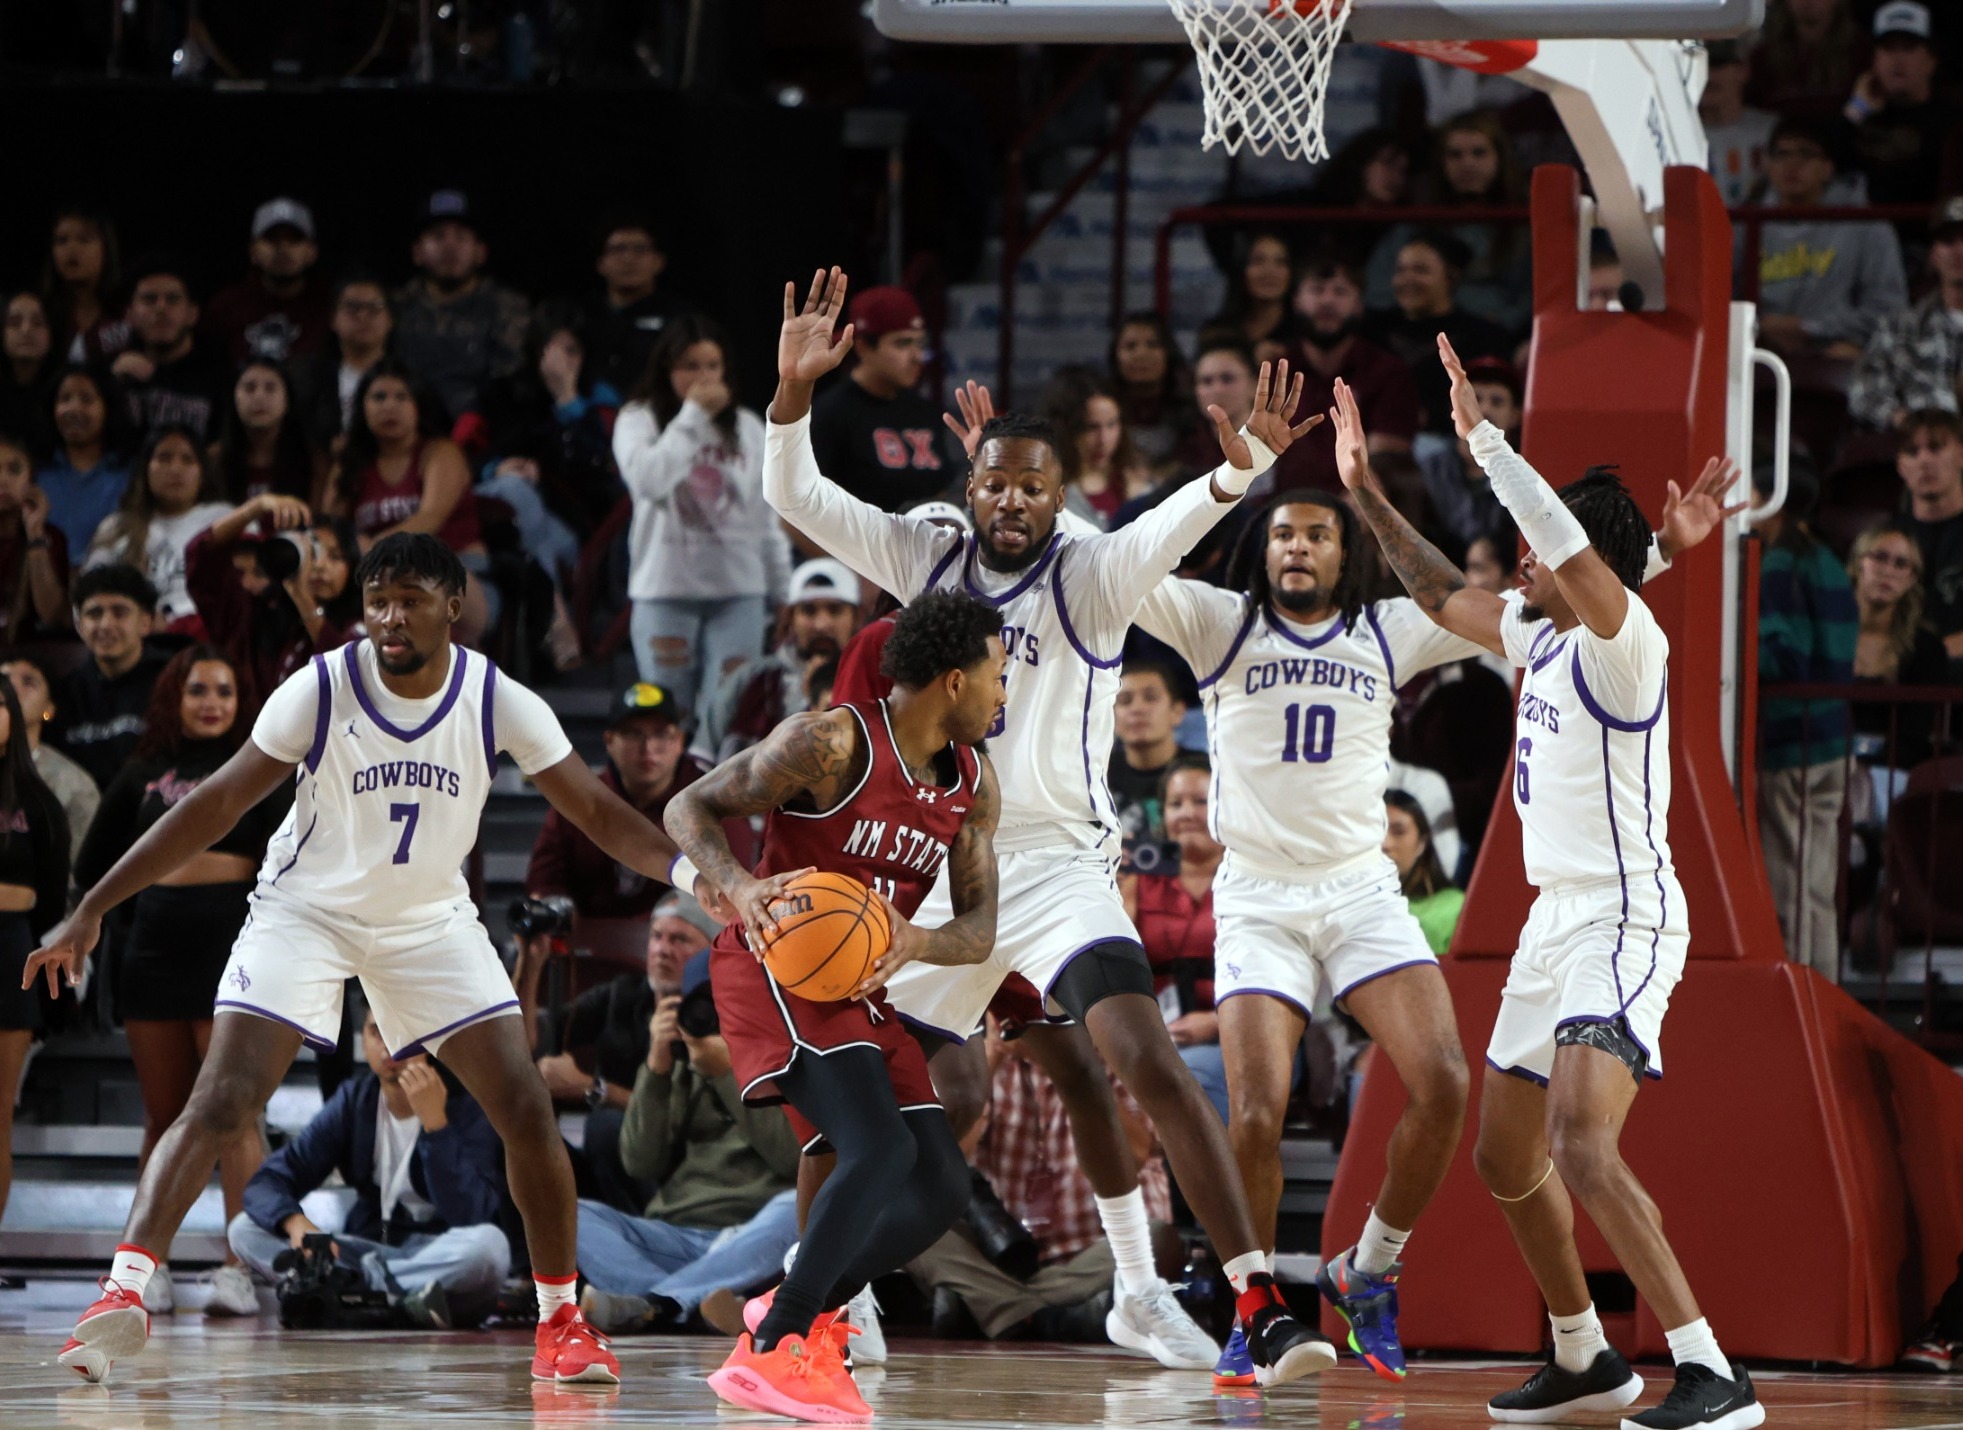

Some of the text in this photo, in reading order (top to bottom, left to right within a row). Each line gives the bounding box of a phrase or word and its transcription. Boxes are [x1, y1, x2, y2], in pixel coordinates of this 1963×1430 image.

[1245, 658, 1377, 702] COWBOYS
[1282, 702, 1336, 764] 10
[353, 761, 460, 798] COWBOYS
[1517, 737, 1533, 805] 6
[390, 803, 420, 865] 7
[842, 819, 887, 858] NM
